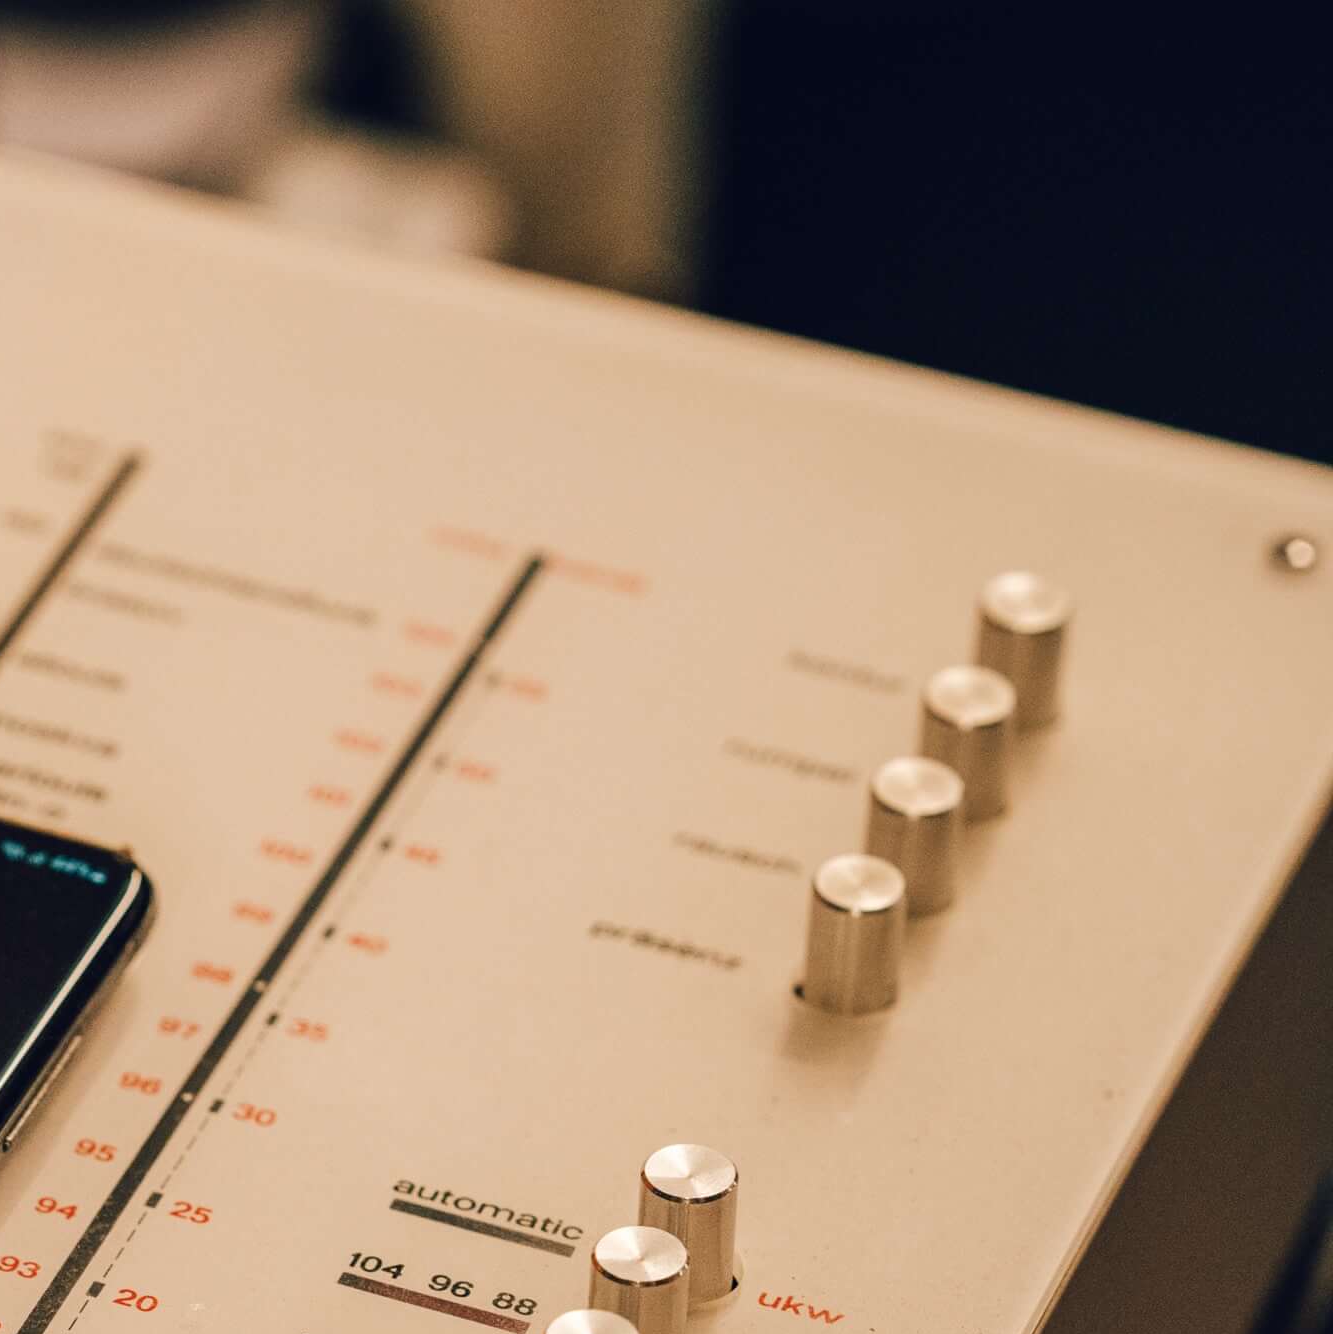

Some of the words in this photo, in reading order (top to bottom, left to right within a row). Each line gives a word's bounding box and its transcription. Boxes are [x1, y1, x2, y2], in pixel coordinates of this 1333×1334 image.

[232, 1102, 277, 1129] 30
[74, 1138, 118, 1164] 95
[34, 1196, 78, 1221] 94
[169, 1200, 214, 1226] 25
[392, 1178, 585, 1242] automatic
[349, 1251, 406, 1280] 104
[428, 1273, 475, 1299] 96
[492, 1291, 539, 1317] 88
[112, 1288, 159, 1313] 20
[756, 1290, 846, 1326] ukw
